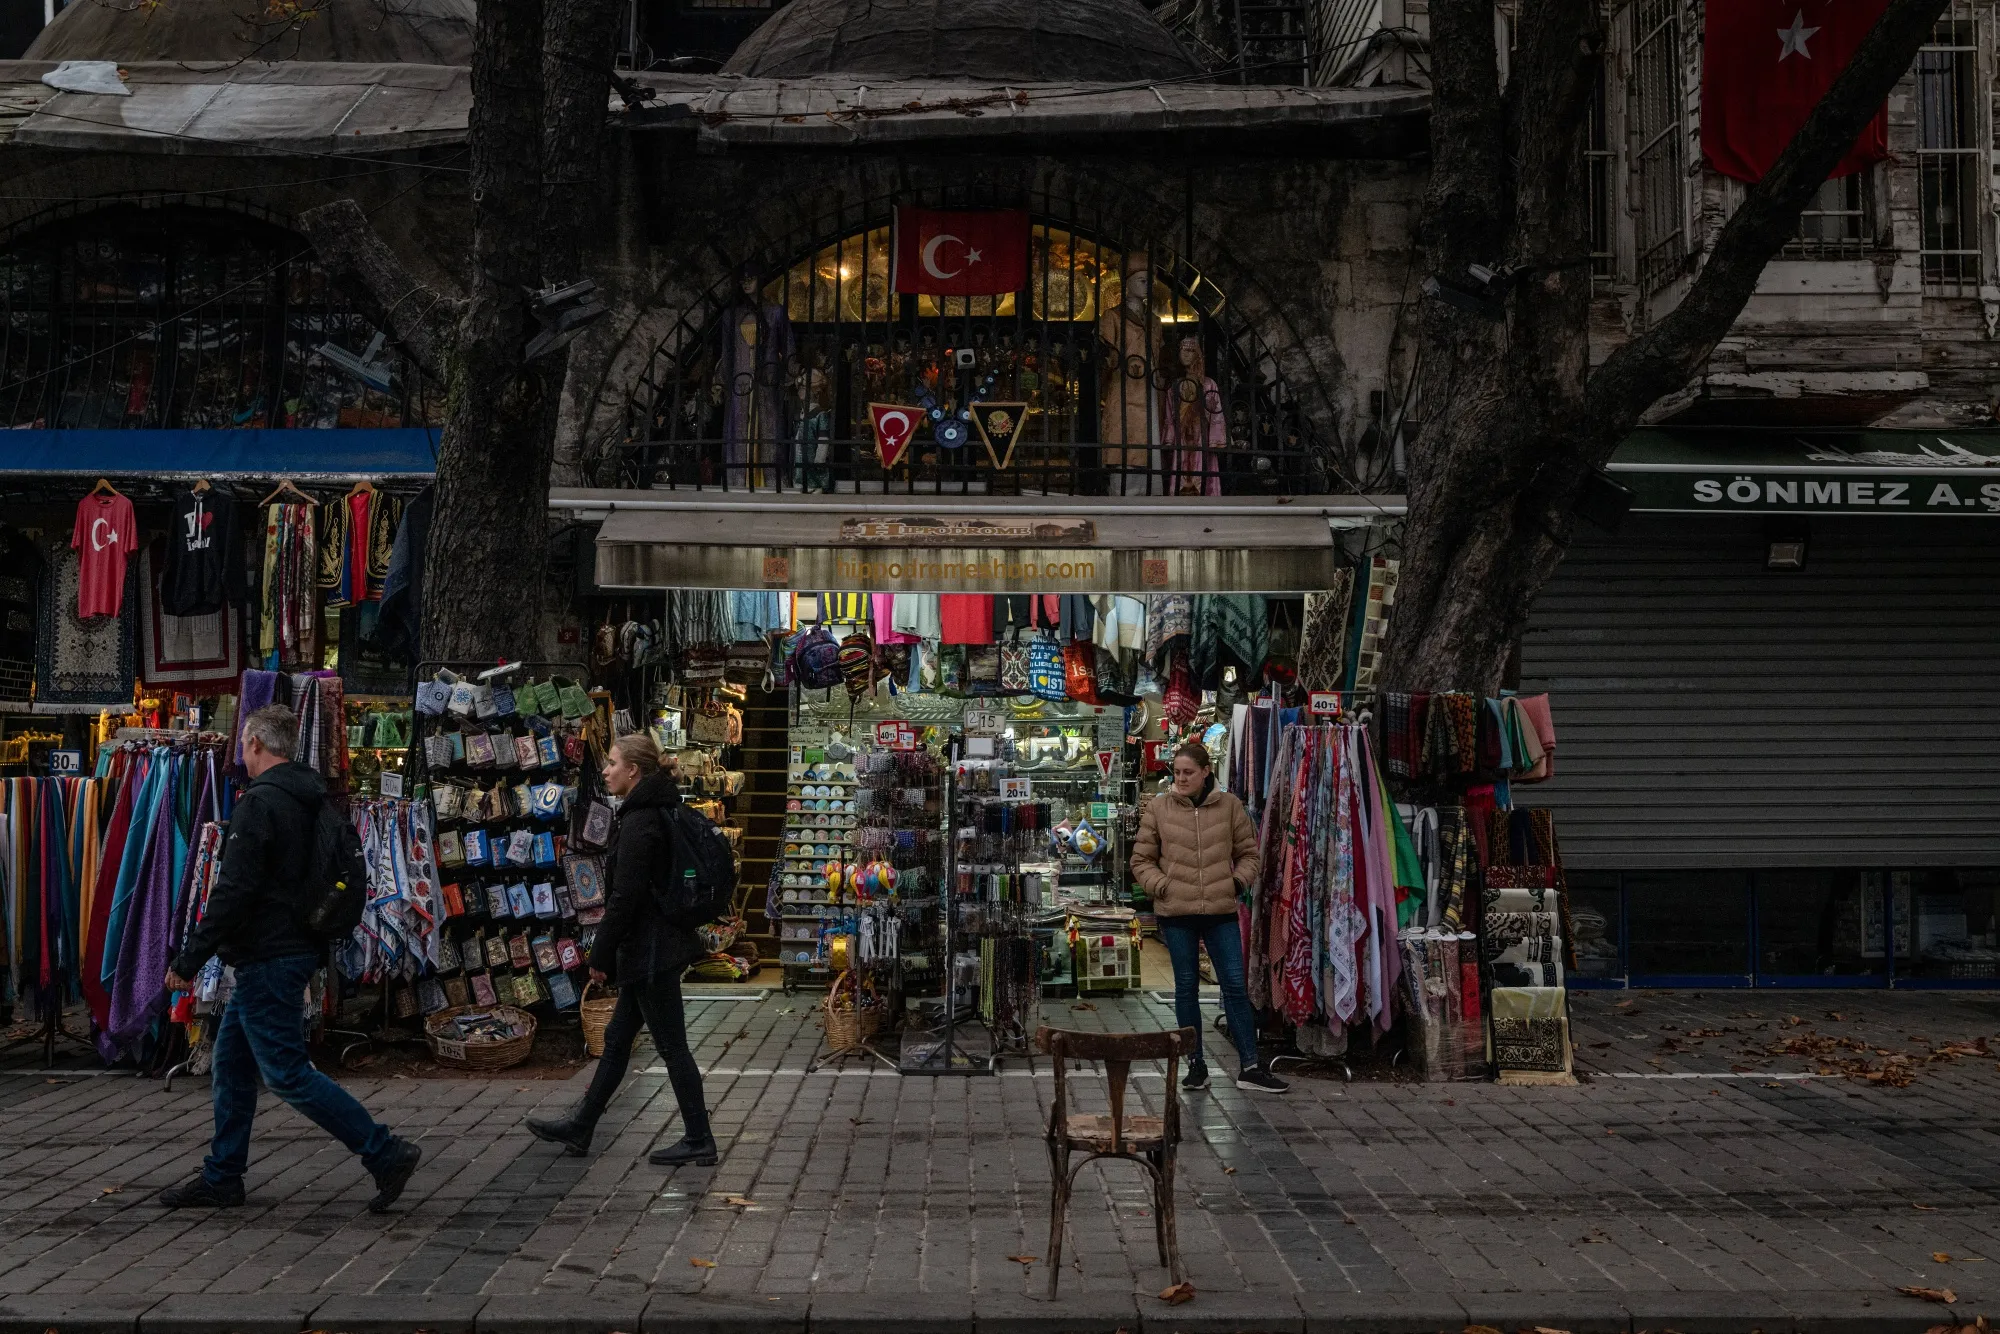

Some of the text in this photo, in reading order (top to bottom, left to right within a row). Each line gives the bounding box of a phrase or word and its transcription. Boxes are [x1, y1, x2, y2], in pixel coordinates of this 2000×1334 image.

[1693, 476, 1910, 505] SÖNMEZ
[837, 553, 1095, 583] hippodromeshop.com
[981, 714, 995, 728] 15
[1006, 789, 1018, 798] 20
